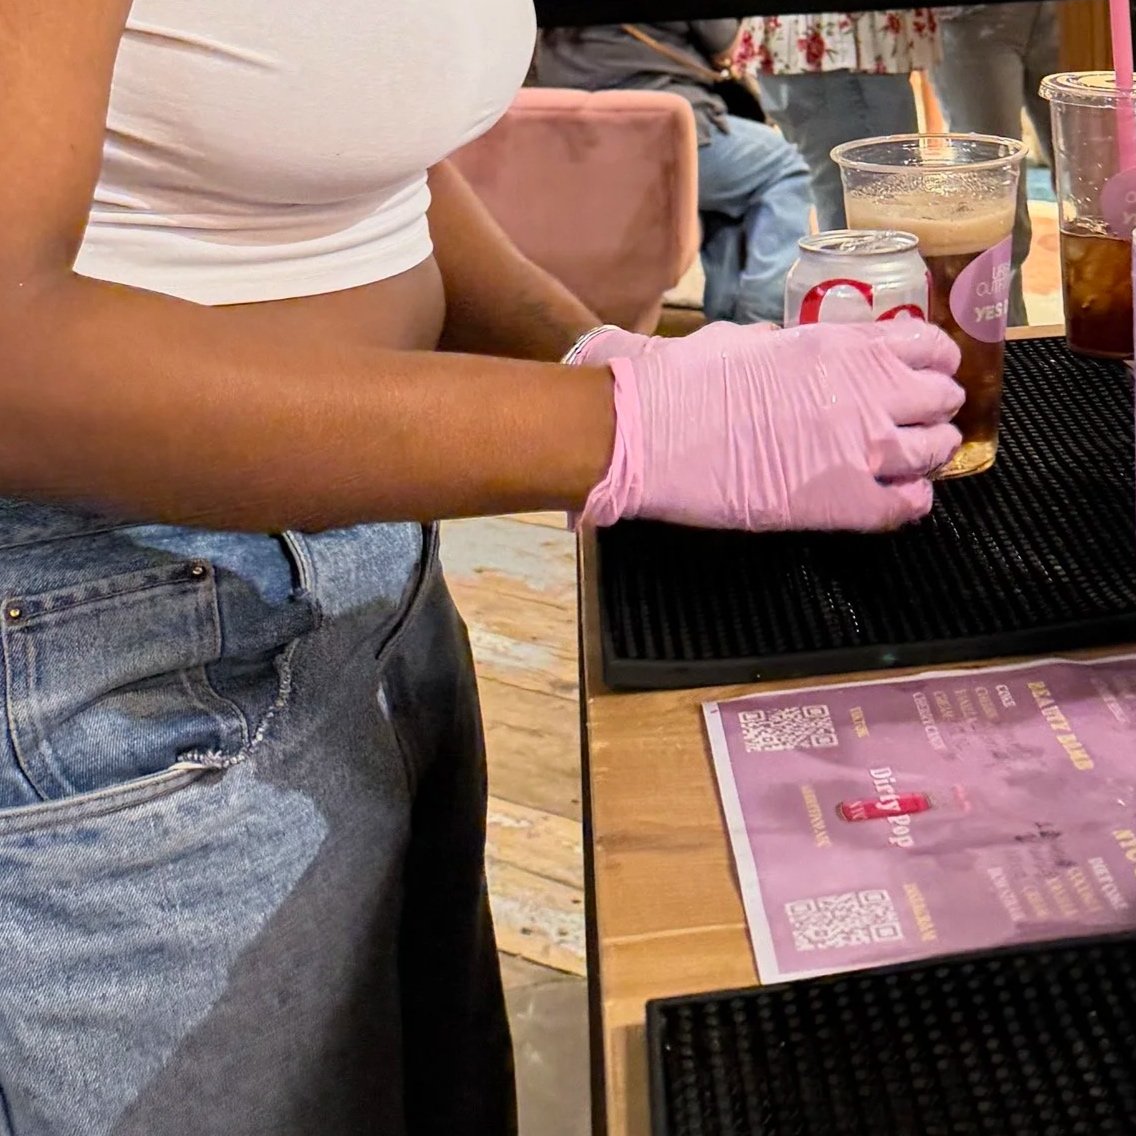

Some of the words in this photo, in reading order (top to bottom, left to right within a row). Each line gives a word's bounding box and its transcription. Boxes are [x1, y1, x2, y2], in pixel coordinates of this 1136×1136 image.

[913, 692, 936, 725] CHERRY
[996, 684, 1016, 707] COKE
[869, 767, 901, 811] Dirty
[888, 813, 914, 848] Pop
[1088, 857, 1113, 885] DIET
